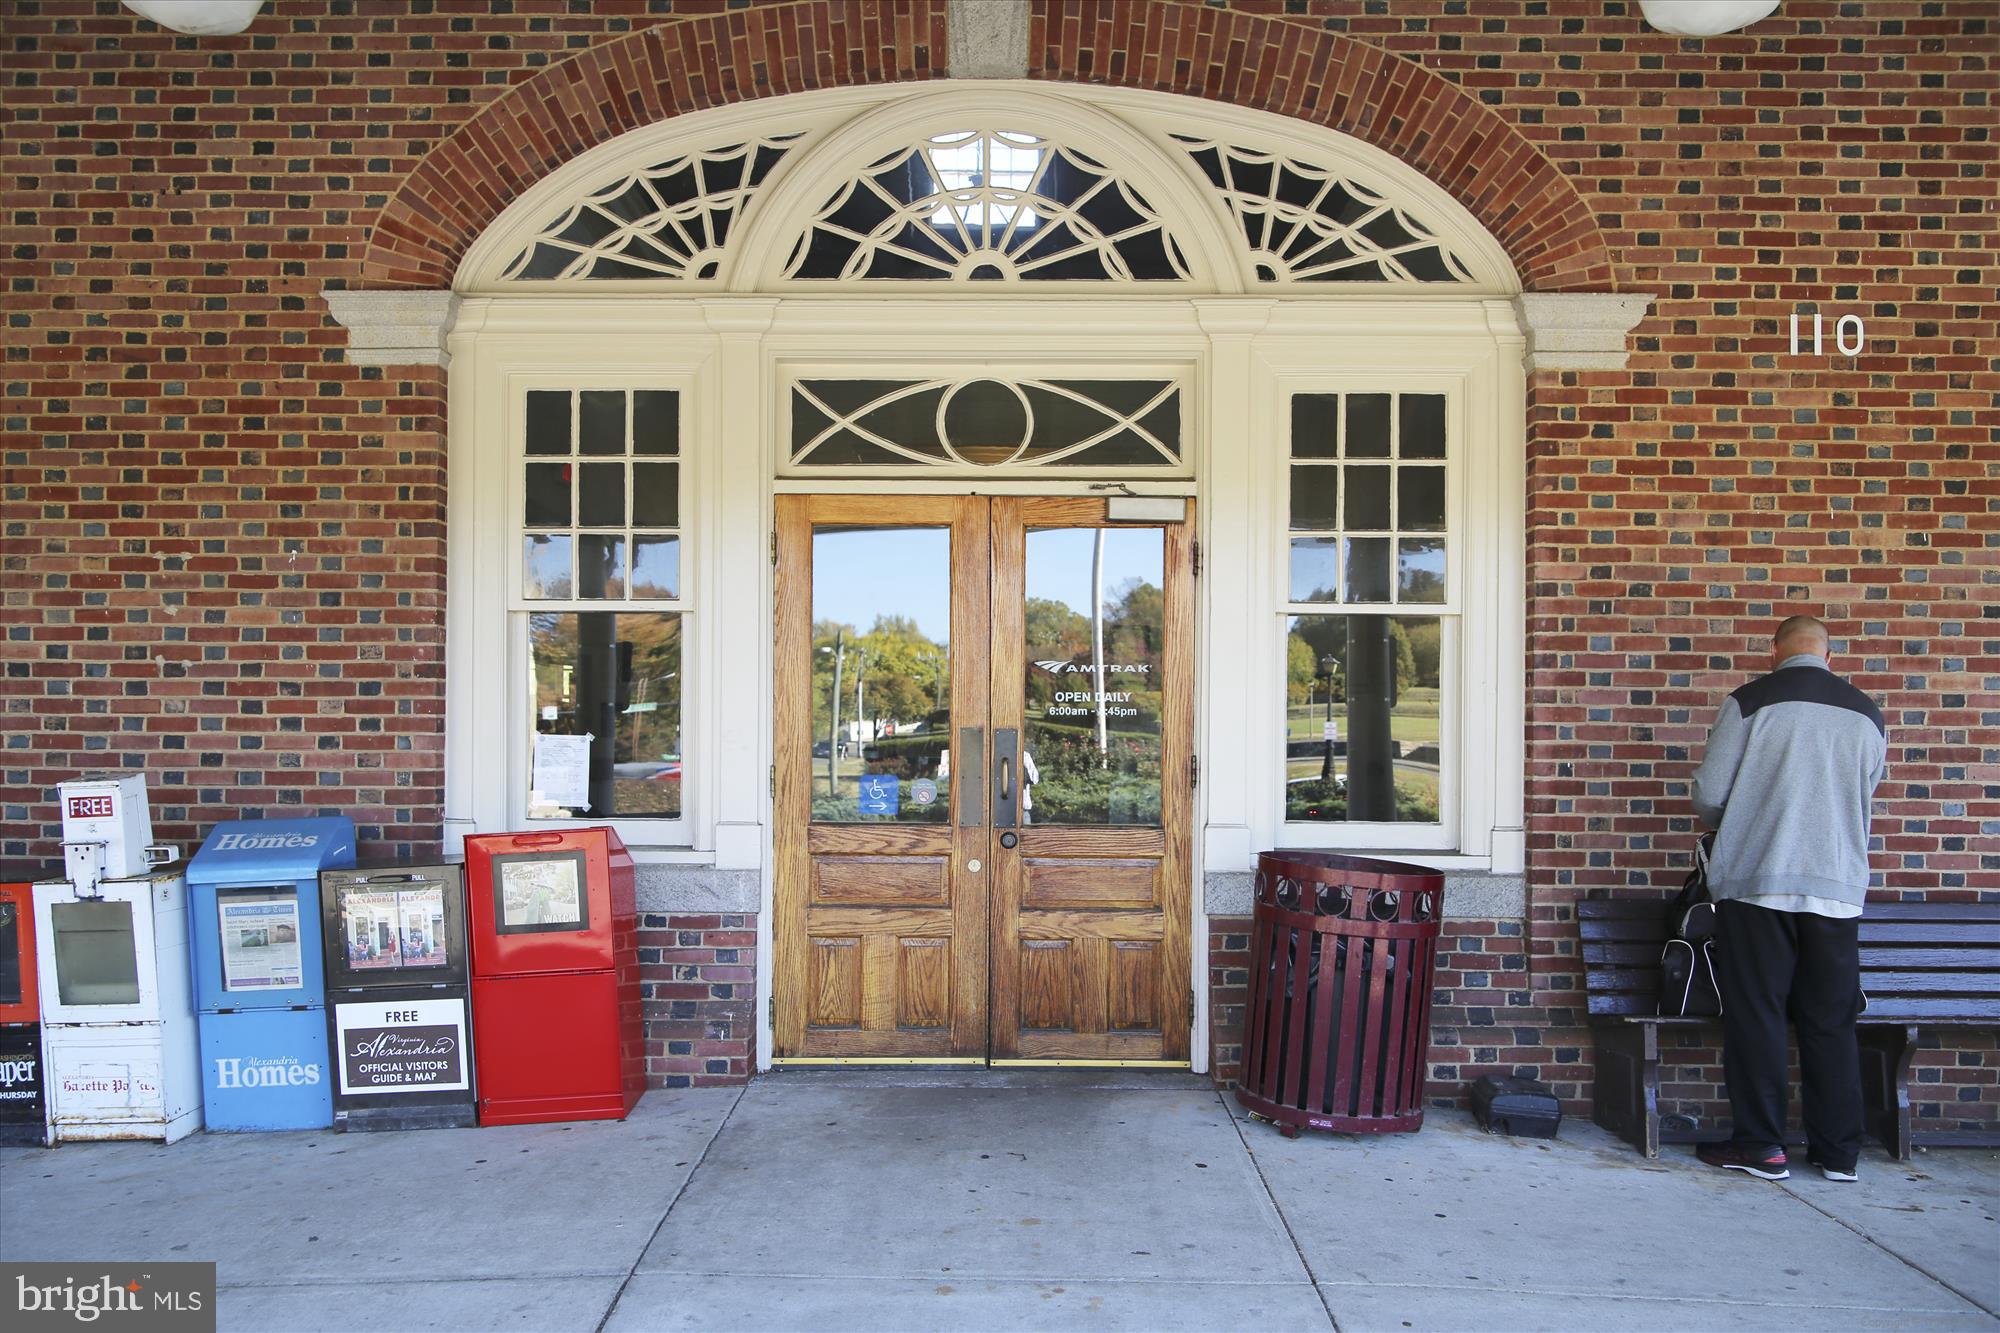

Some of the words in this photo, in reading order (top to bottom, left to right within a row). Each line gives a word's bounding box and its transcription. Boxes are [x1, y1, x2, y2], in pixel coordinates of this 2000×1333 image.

[1790, 313, 1864, 357] 110
[1065, 664, 1150, 673] AMTRAK
[1055, 691, 1091, 702] OPEN
[1049, 706, 1088, 716] 6:00am
[1098, 706, 1137, 716] :45pm
[70, 797, 112, 816] FREE
[211, 832, 319, 851] Homes
[347, 897, 395, 905] ALEXANDRIA
[385, 1010, 419, 1022] FREE
[350, 1032, 455, 1058] Alexandria
[388, 1034, 423, 1046] Virginia
[245, 1056, 298, 1067] Alexandria
[358, 1063, 404, 1073] OFFICIAL
[405, 1061, 449, 1071] VISITORS
[216, 1058, 320, 1088] Homes
[371, 1073, 402, 1083] GUIDE
[405, 1073, 412, 1082] &
[414, 1072, 437, 1081] MAP
